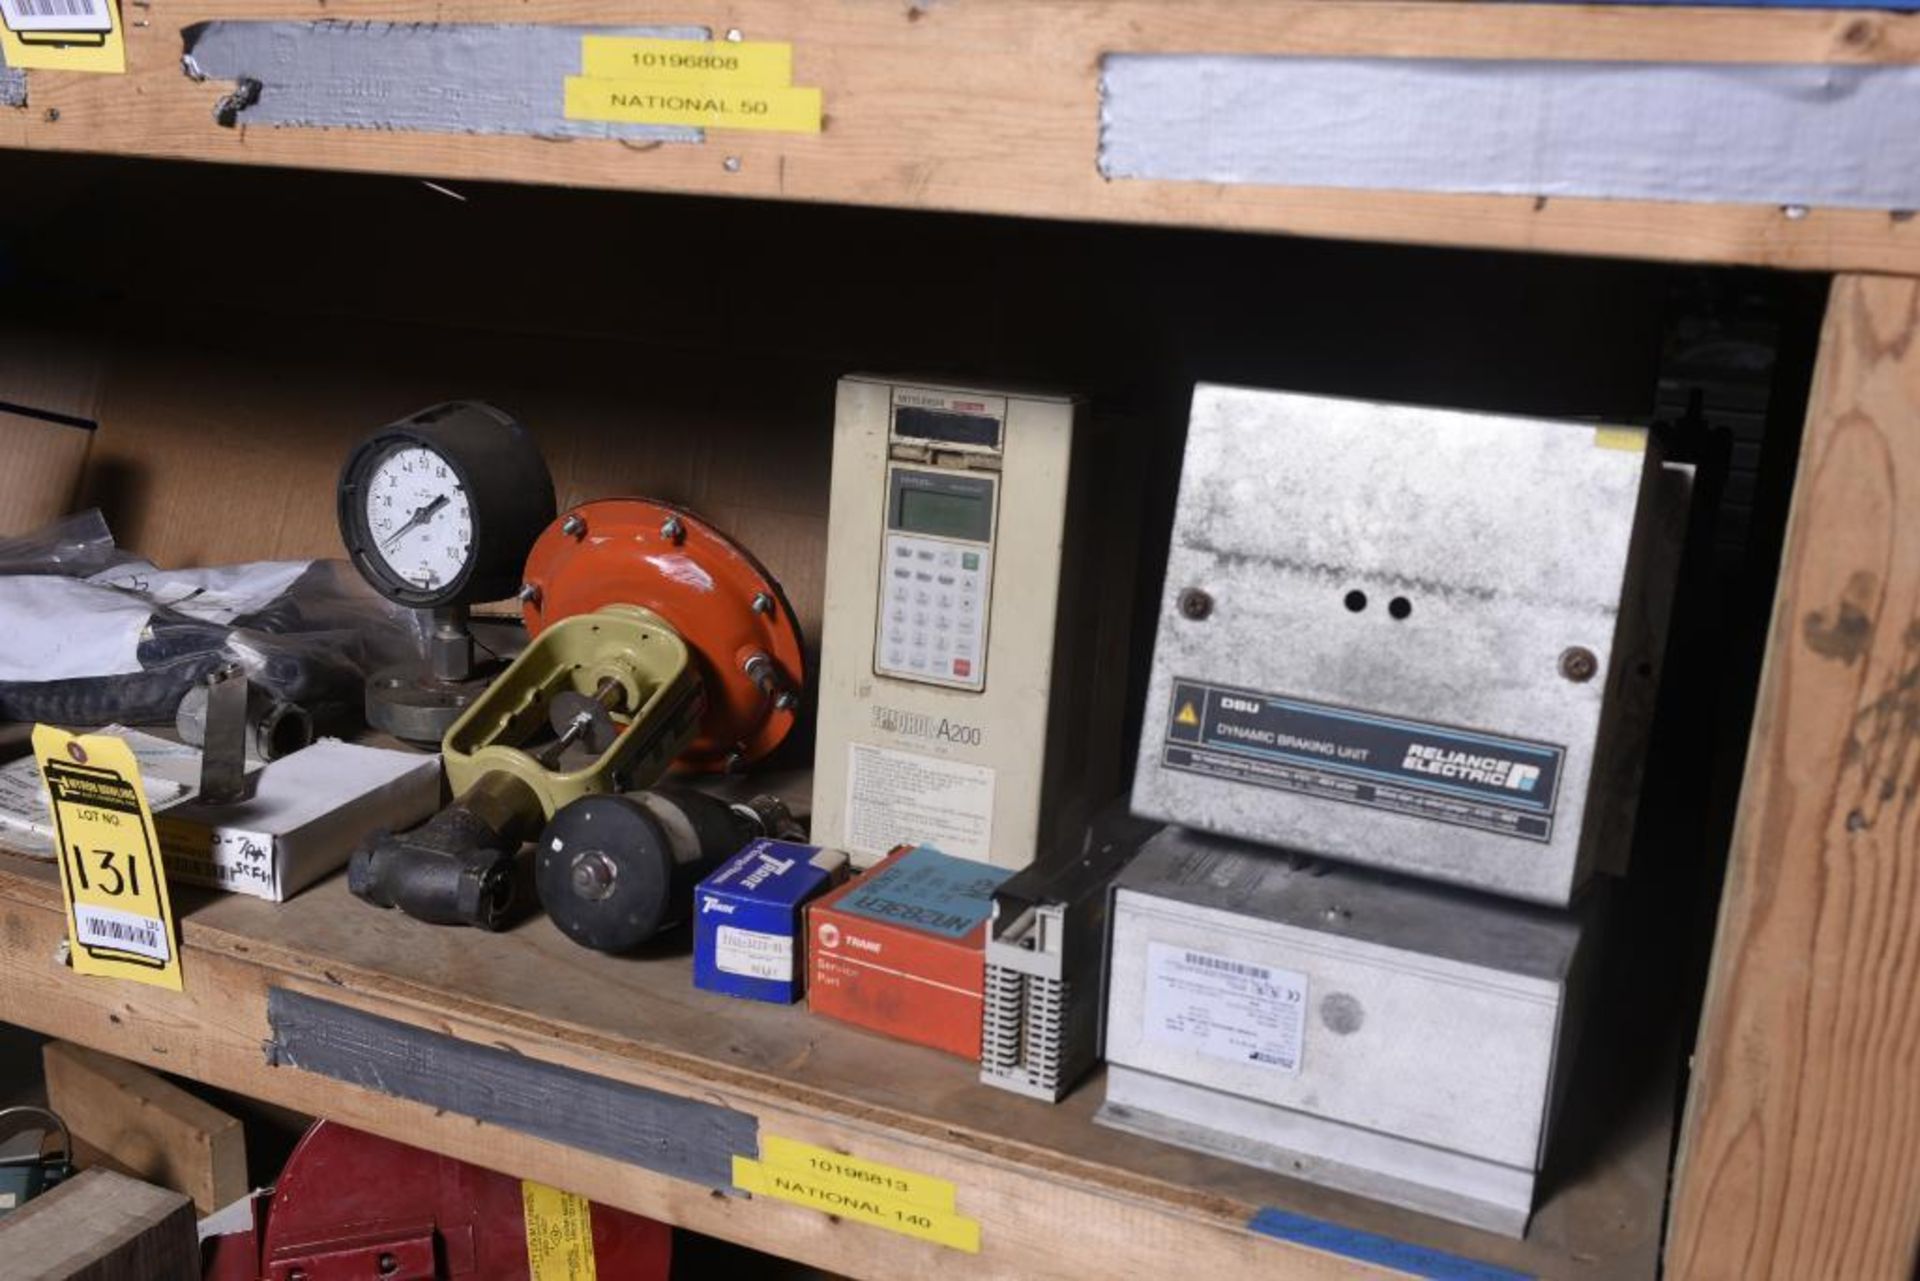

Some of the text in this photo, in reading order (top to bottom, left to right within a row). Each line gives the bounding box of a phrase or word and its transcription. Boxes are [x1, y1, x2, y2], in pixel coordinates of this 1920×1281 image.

[631, 52, 739, 71] 10196808
[610, 93, 769, 115] NATIONAL 50
[1220, 697, 1260, 715] DBU
[1216, 722, 1371, 762] DYNAMIC BRAKING UNIT
[1401, 756, 1507, 787] ELECTRIC
[1407, 743, 1513, 773] RELIANCE
[76, 808, 99, 822] LOT
[73, 845, 140, 897] 131
[845, 934, 882, 955] TRANE
[808, 1157, 909, 1193] 10196813
[774, 1176, 933, 1230] NATIONAL 140
